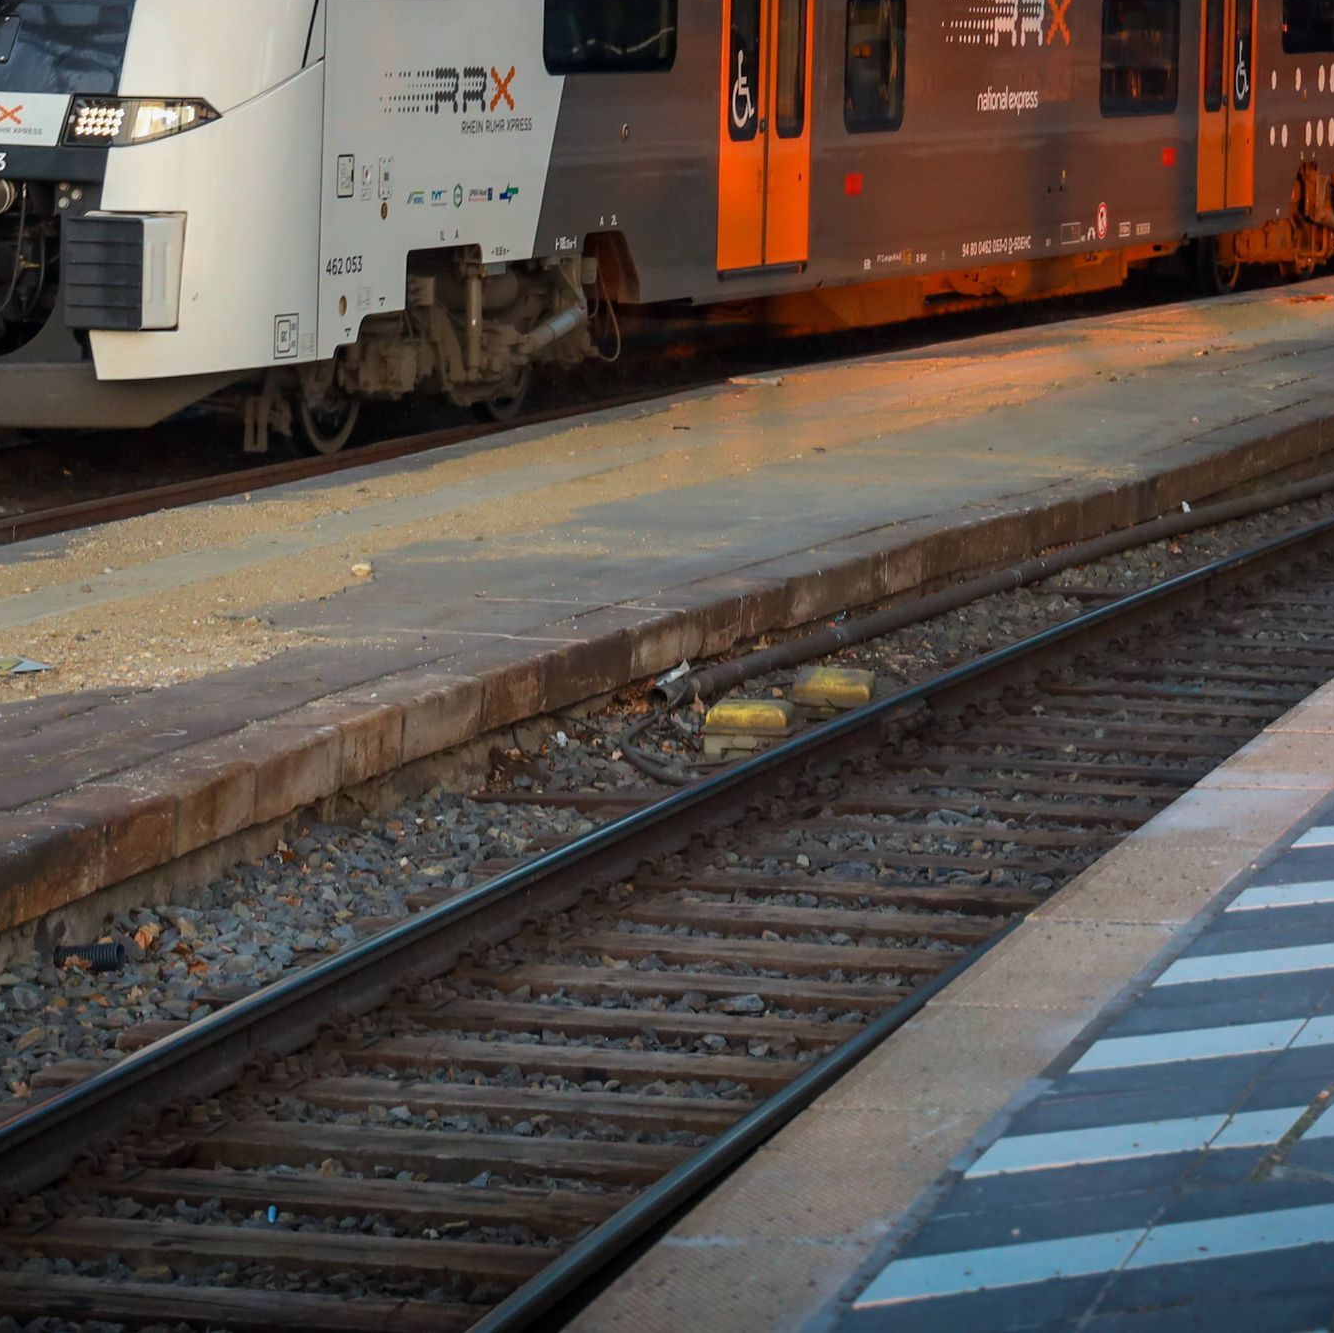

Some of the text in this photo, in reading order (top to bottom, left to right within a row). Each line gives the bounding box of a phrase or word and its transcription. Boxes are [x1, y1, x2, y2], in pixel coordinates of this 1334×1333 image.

[434, 66, 516, 114] RRX
[12, 126, 43, 136] XPRESS
[461, 118, 533, 135] RHEIN RUHR XPRESS
[962, 243, 970, 258] 94
[970, 242, 978, 256] 80
[978, 239, 992, 255] 0462
[992, 238, 1008, 253] 053-0
[326, 255, 364, 276] 462 053
